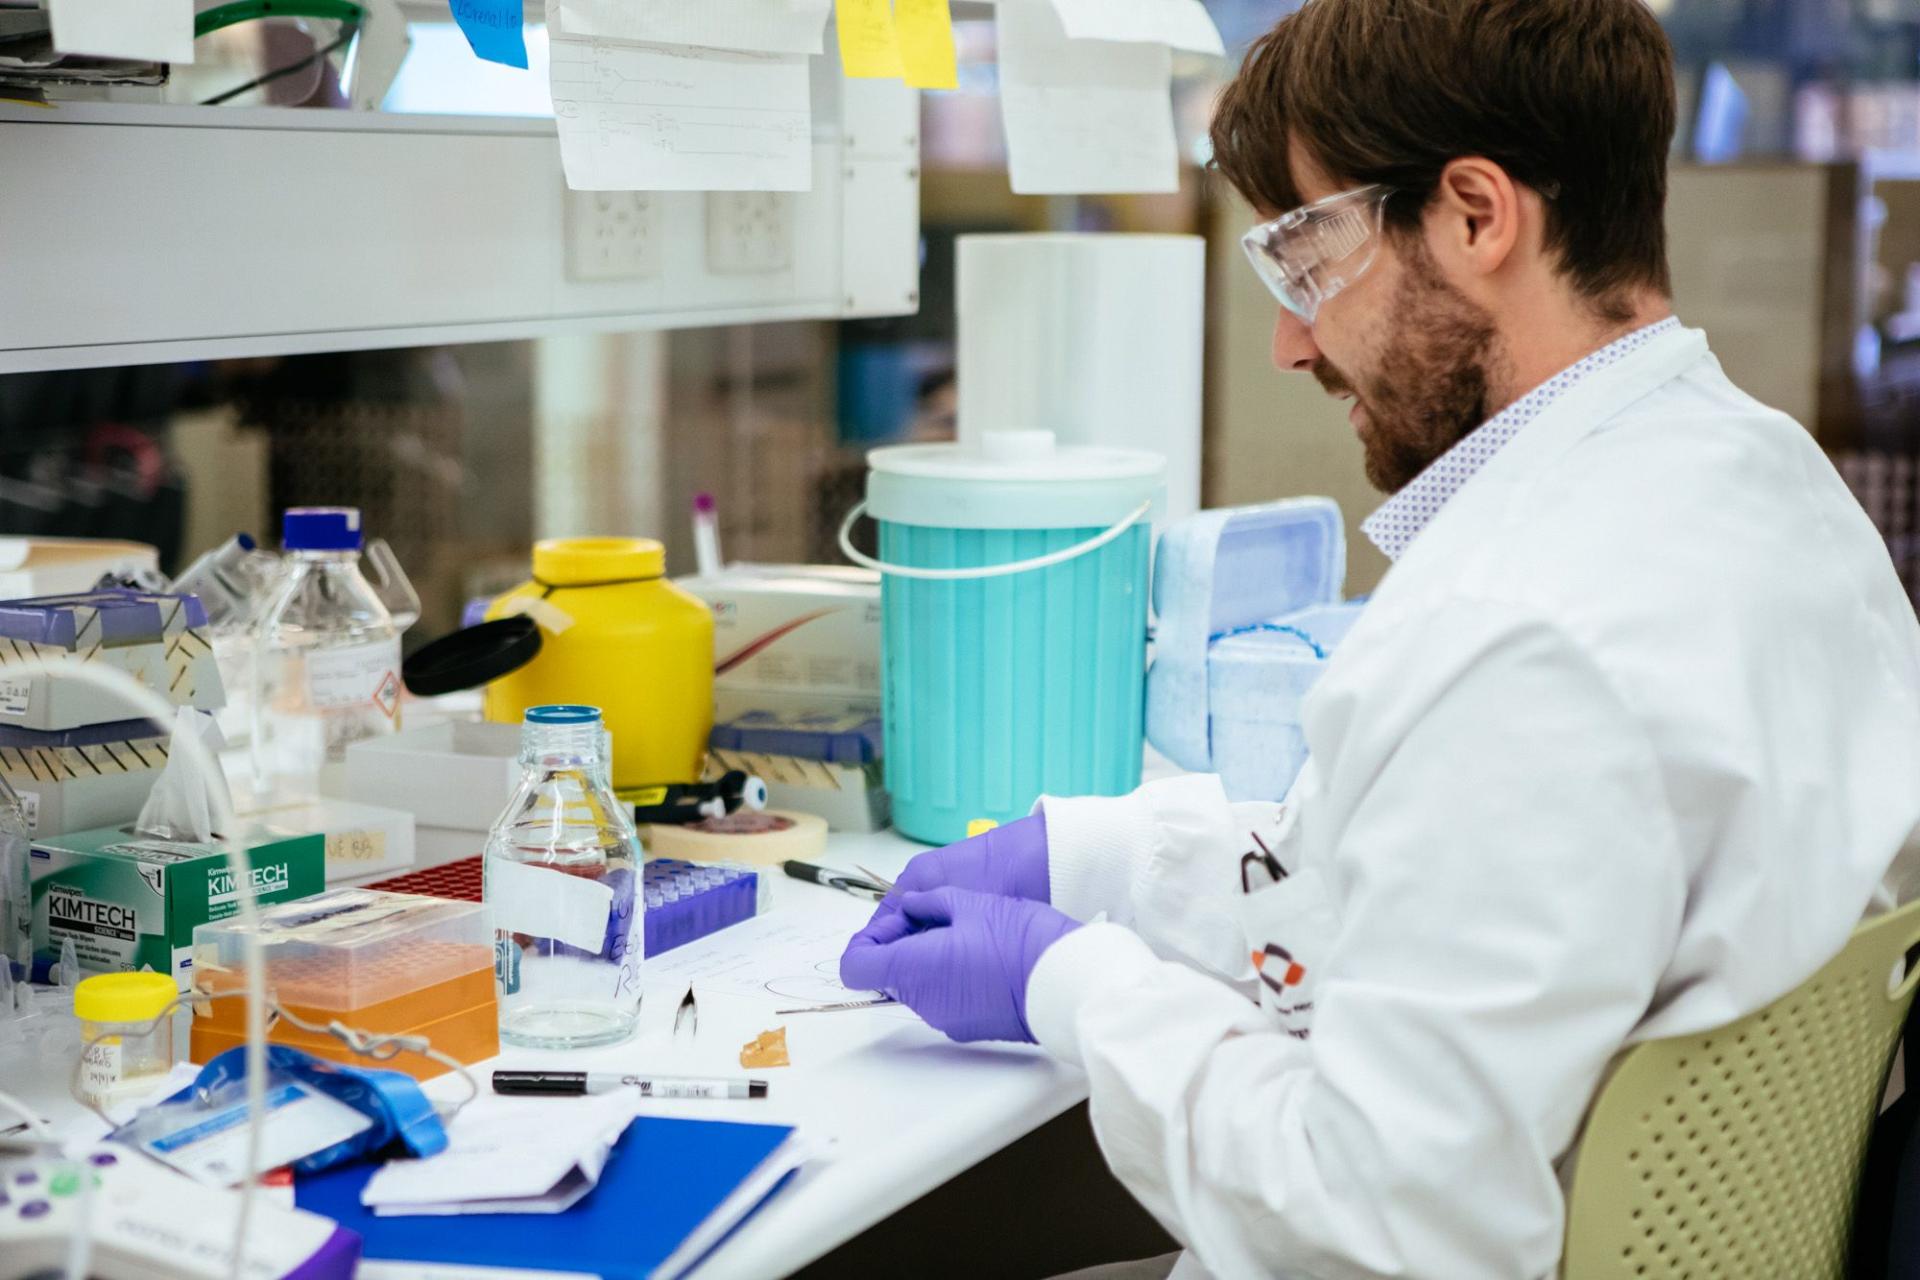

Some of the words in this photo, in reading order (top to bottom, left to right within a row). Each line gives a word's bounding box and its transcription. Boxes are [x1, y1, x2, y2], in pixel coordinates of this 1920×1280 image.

[156, 869, 161, 888] 1
[208, 862, 288, 895] KIMECH
[48, 895, 135, 929] KIMTECH
[94, 925, 118, 936] SCIENCE
